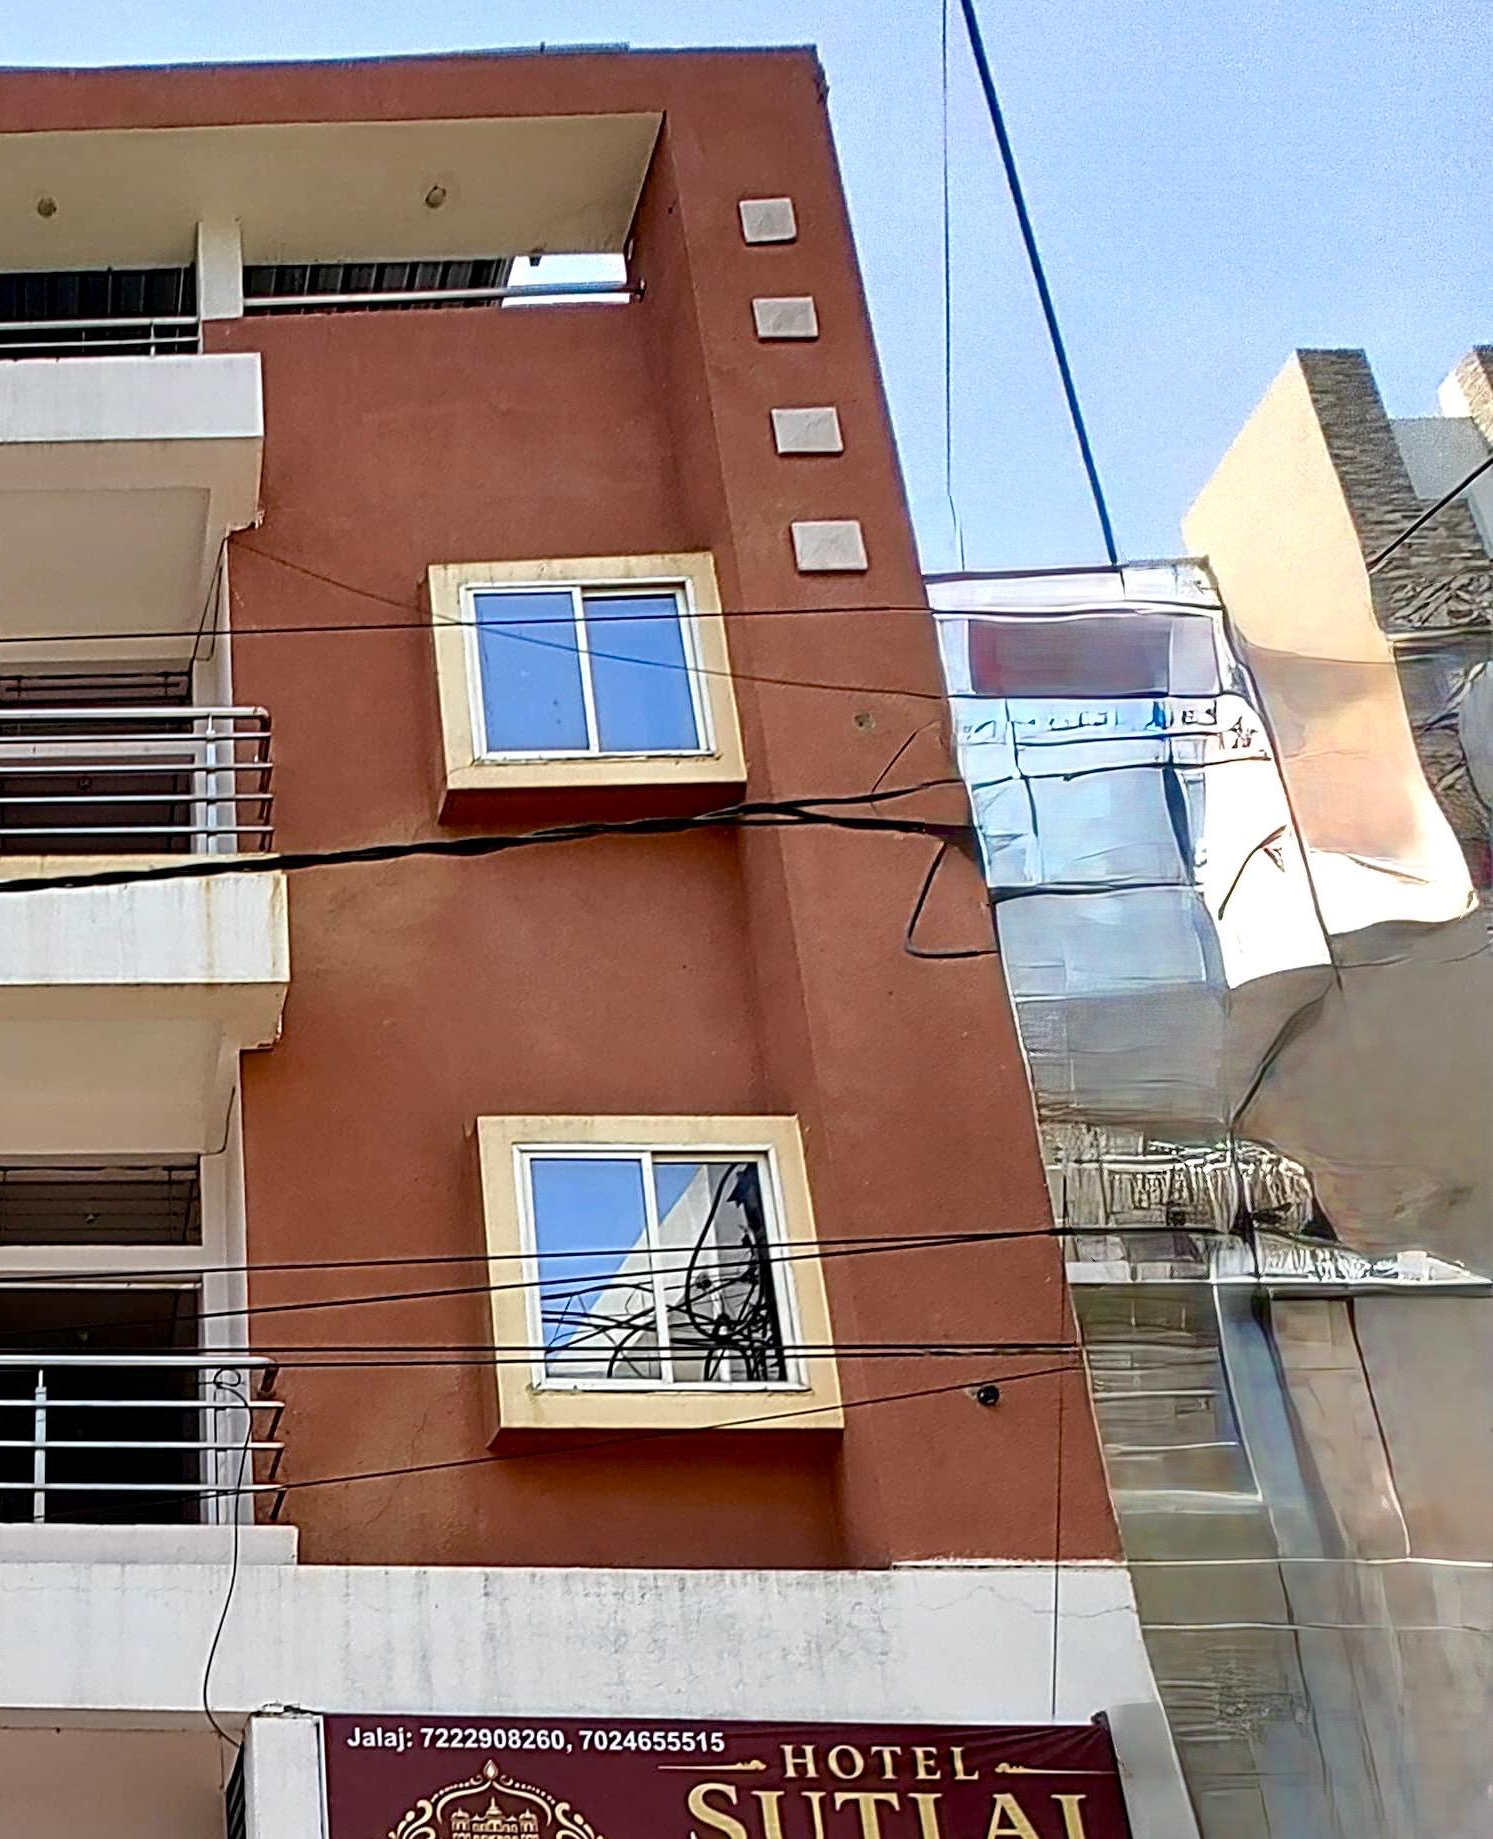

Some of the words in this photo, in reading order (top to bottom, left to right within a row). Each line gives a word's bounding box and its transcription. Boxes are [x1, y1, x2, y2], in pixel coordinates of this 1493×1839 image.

[347, 1727, 413, 1752] Jalaj:
[420, 1728, 573, 1753] 7222908260,
[579, 1730, 725, 1752] 7024655515
[780, 1744, 980, 1780] HOTEL
